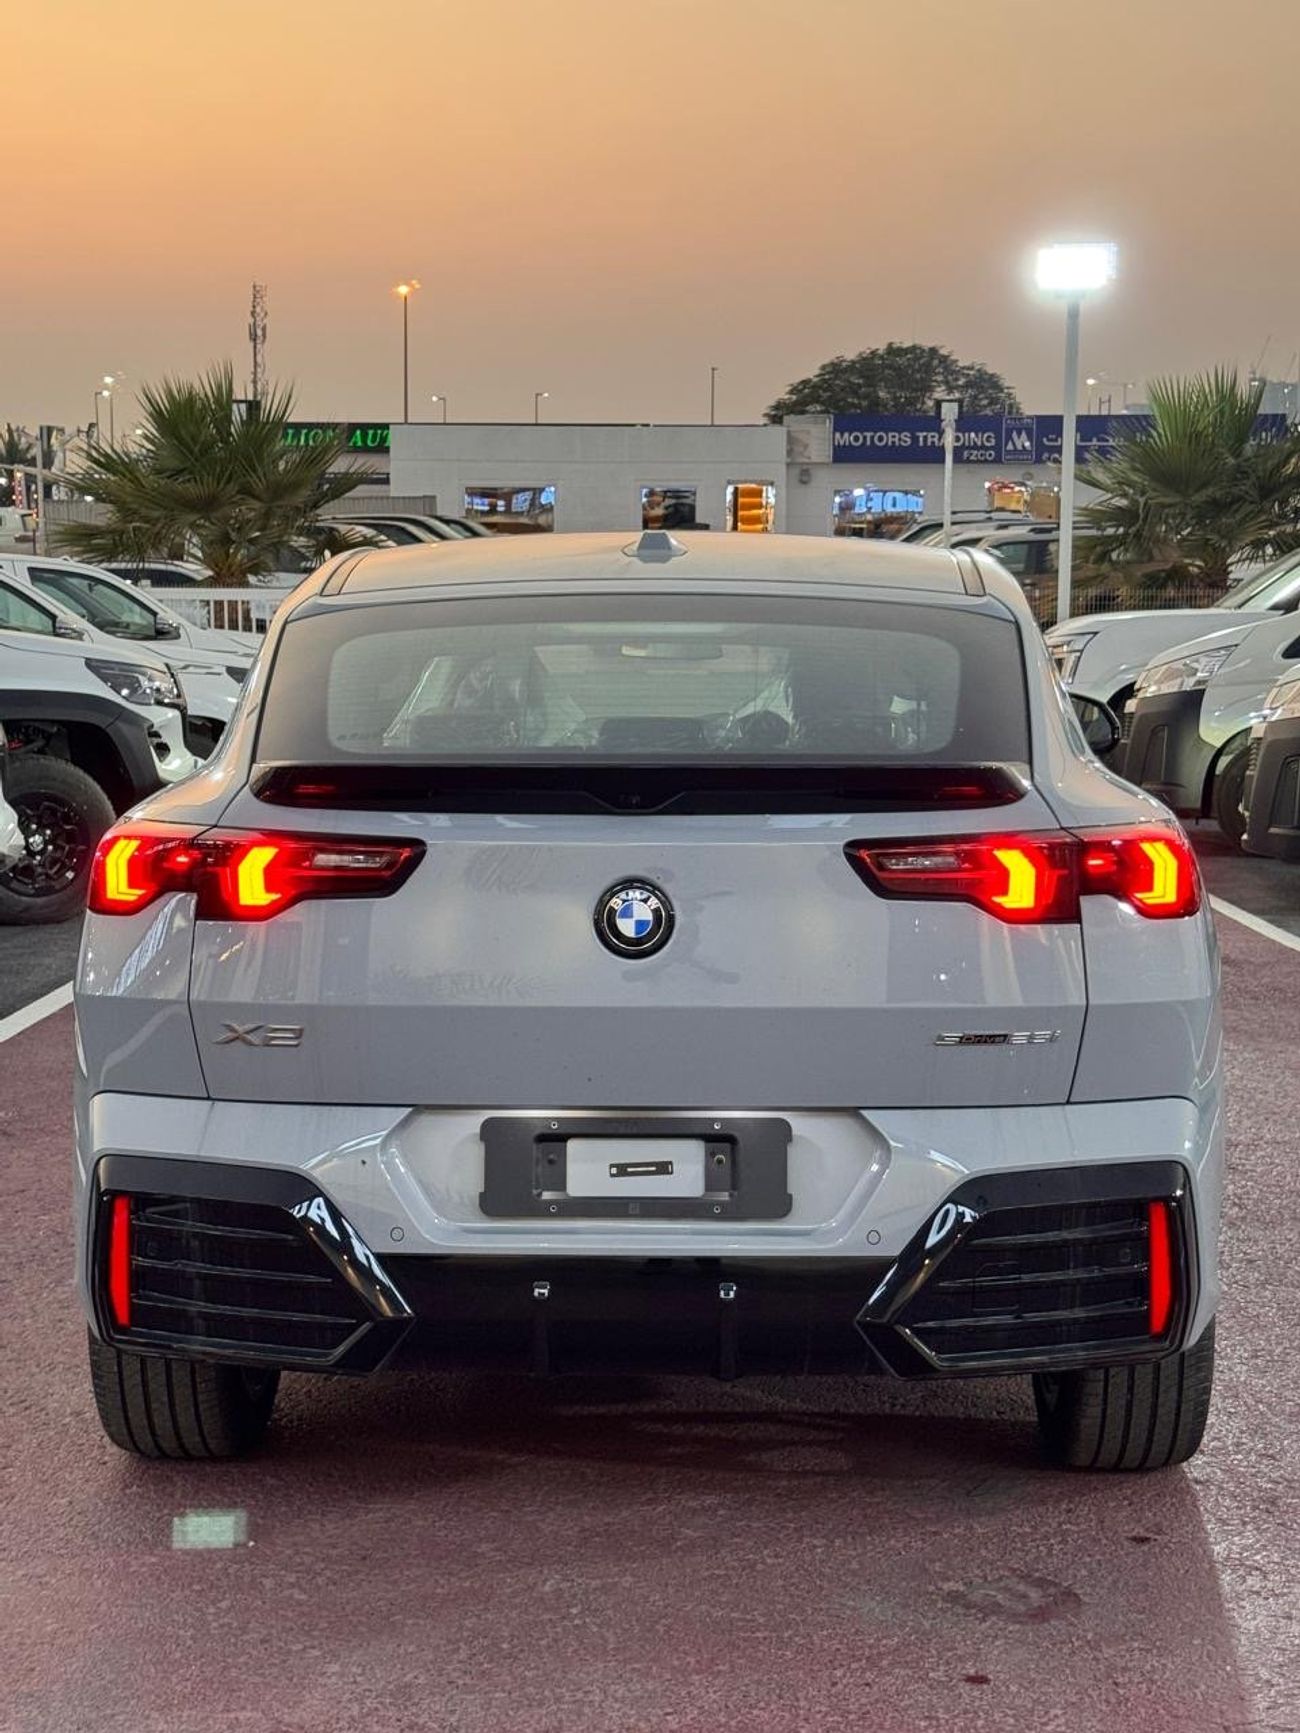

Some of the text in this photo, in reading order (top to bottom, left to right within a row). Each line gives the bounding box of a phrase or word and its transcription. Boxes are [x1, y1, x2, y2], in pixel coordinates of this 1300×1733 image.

[834, 431, 912, 447] MOTORS
[963, 450, 996, 460] FZCO
[609, 889, 661, 909] BMW
[212, 1022, 304, 1047] X2
